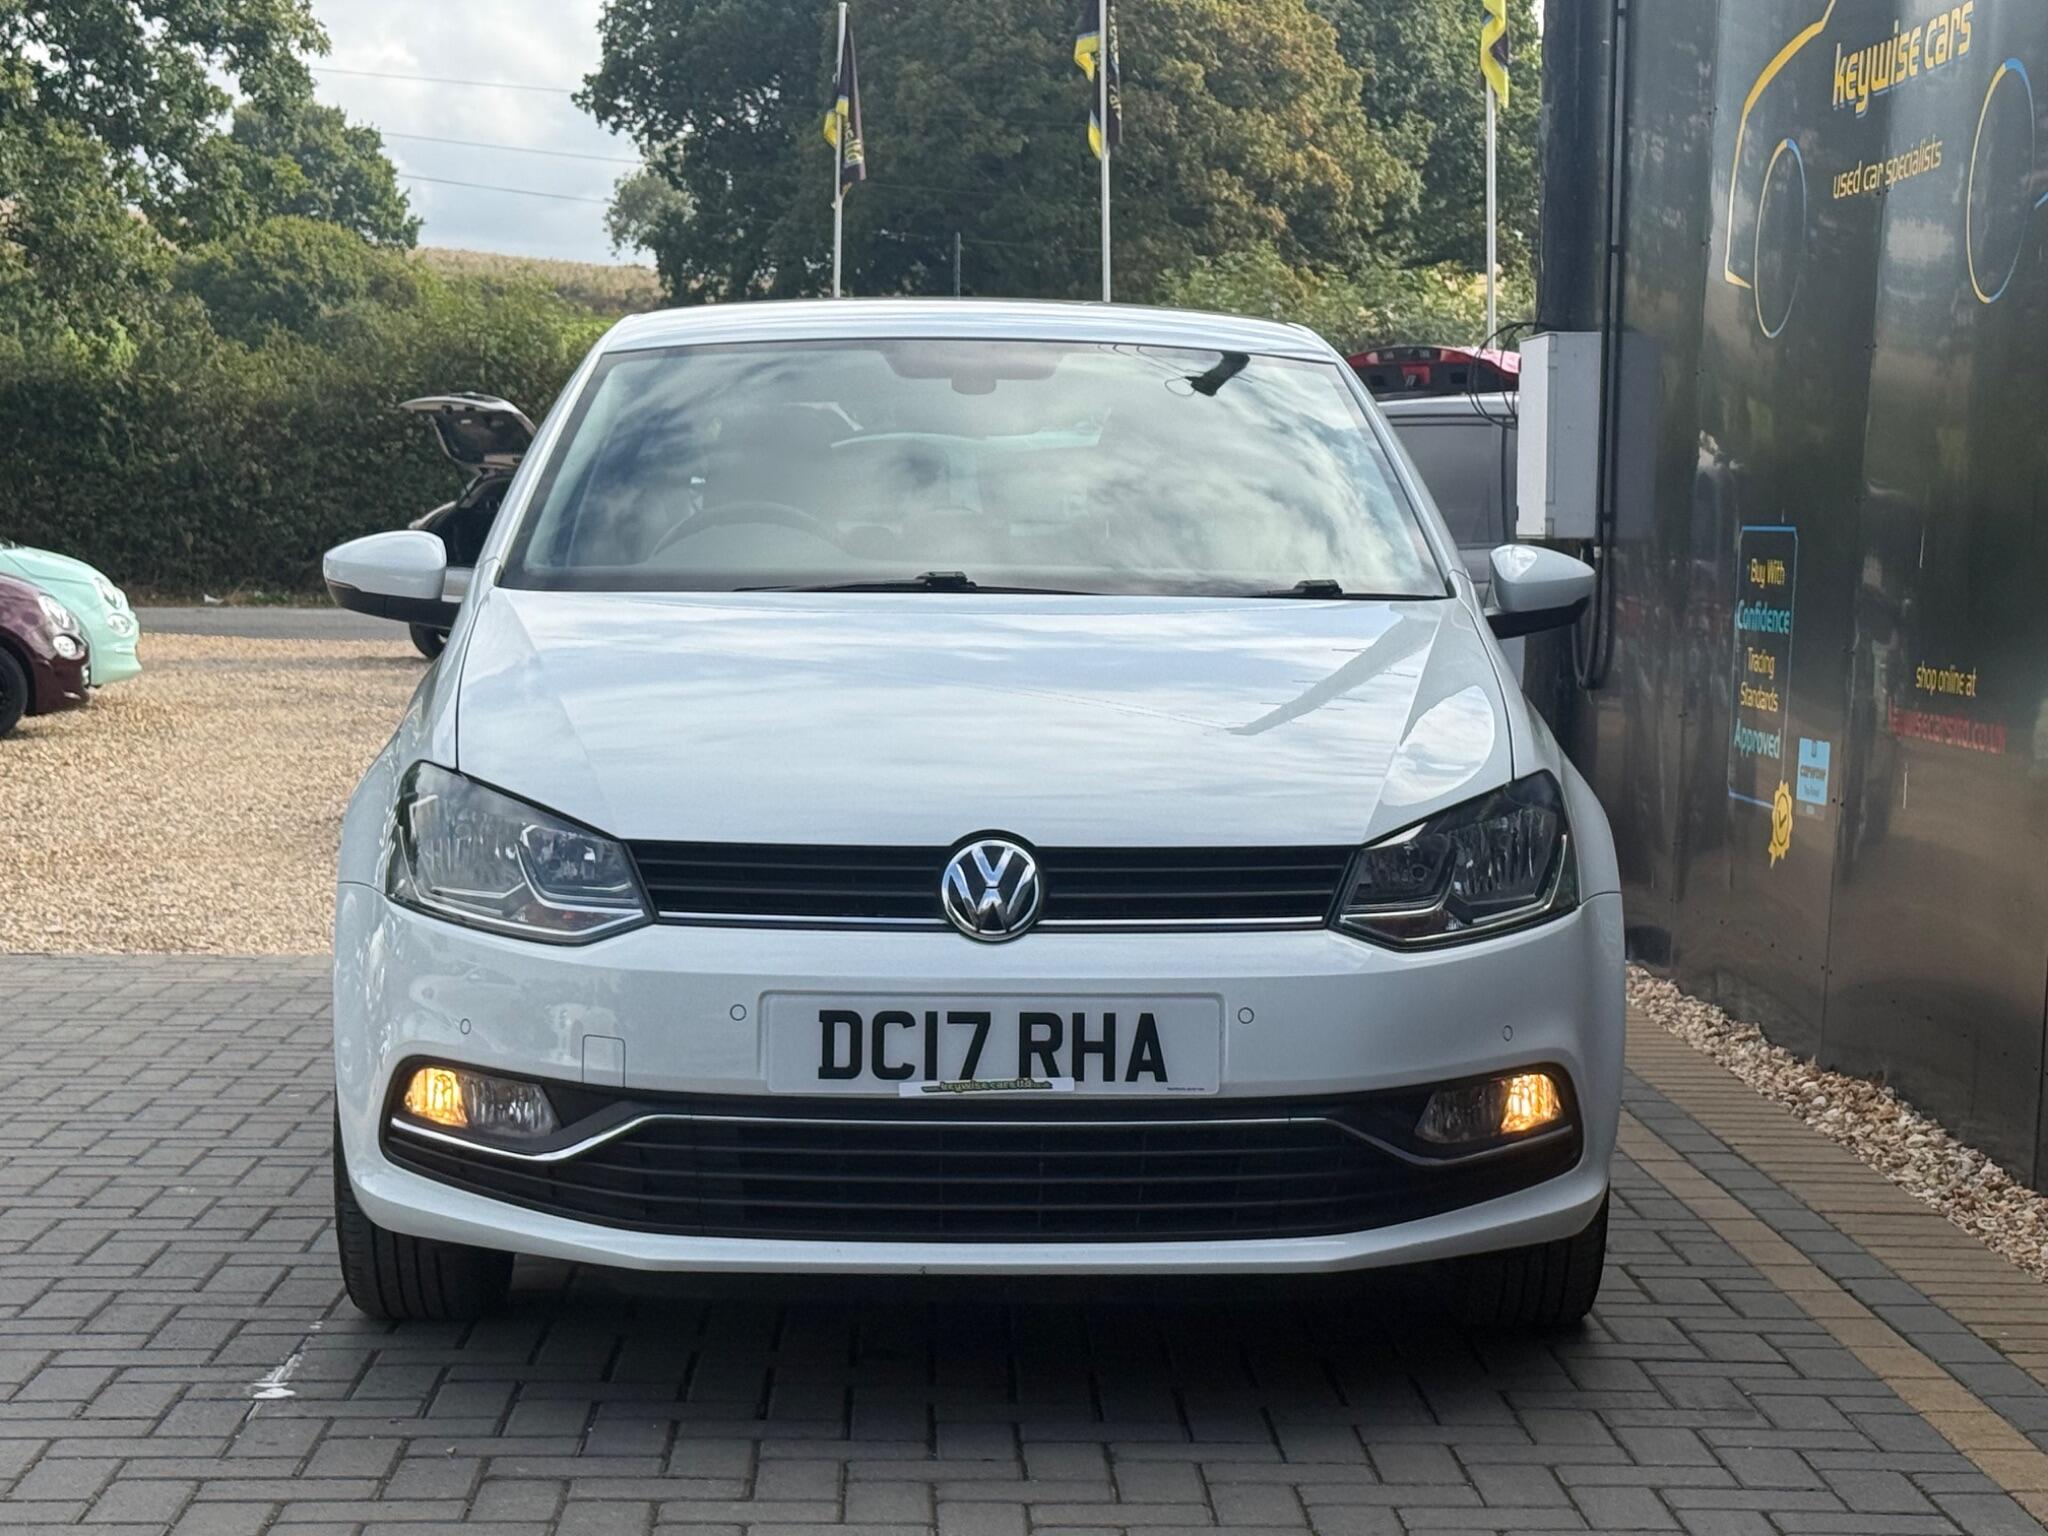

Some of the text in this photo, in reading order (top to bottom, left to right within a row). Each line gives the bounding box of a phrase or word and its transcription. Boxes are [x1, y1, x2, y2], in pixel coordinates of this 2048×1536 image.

[1833, 0, 1974, 117] keywise cars
[1833, 133, 1943, 199] used car specialists
[1750, 557, 1785, 589] Buy With
[1736, 599, 1790, 634] Confidence
[1747, 646, 1775, 680] Trading
[1915, 660, 1977, 697] shop online at
[1740, 681, 1779, 713] Standards
[1733, 717, 1781, 760] Approved
[818, 1010, 1169, 1083] DC17 RHA
